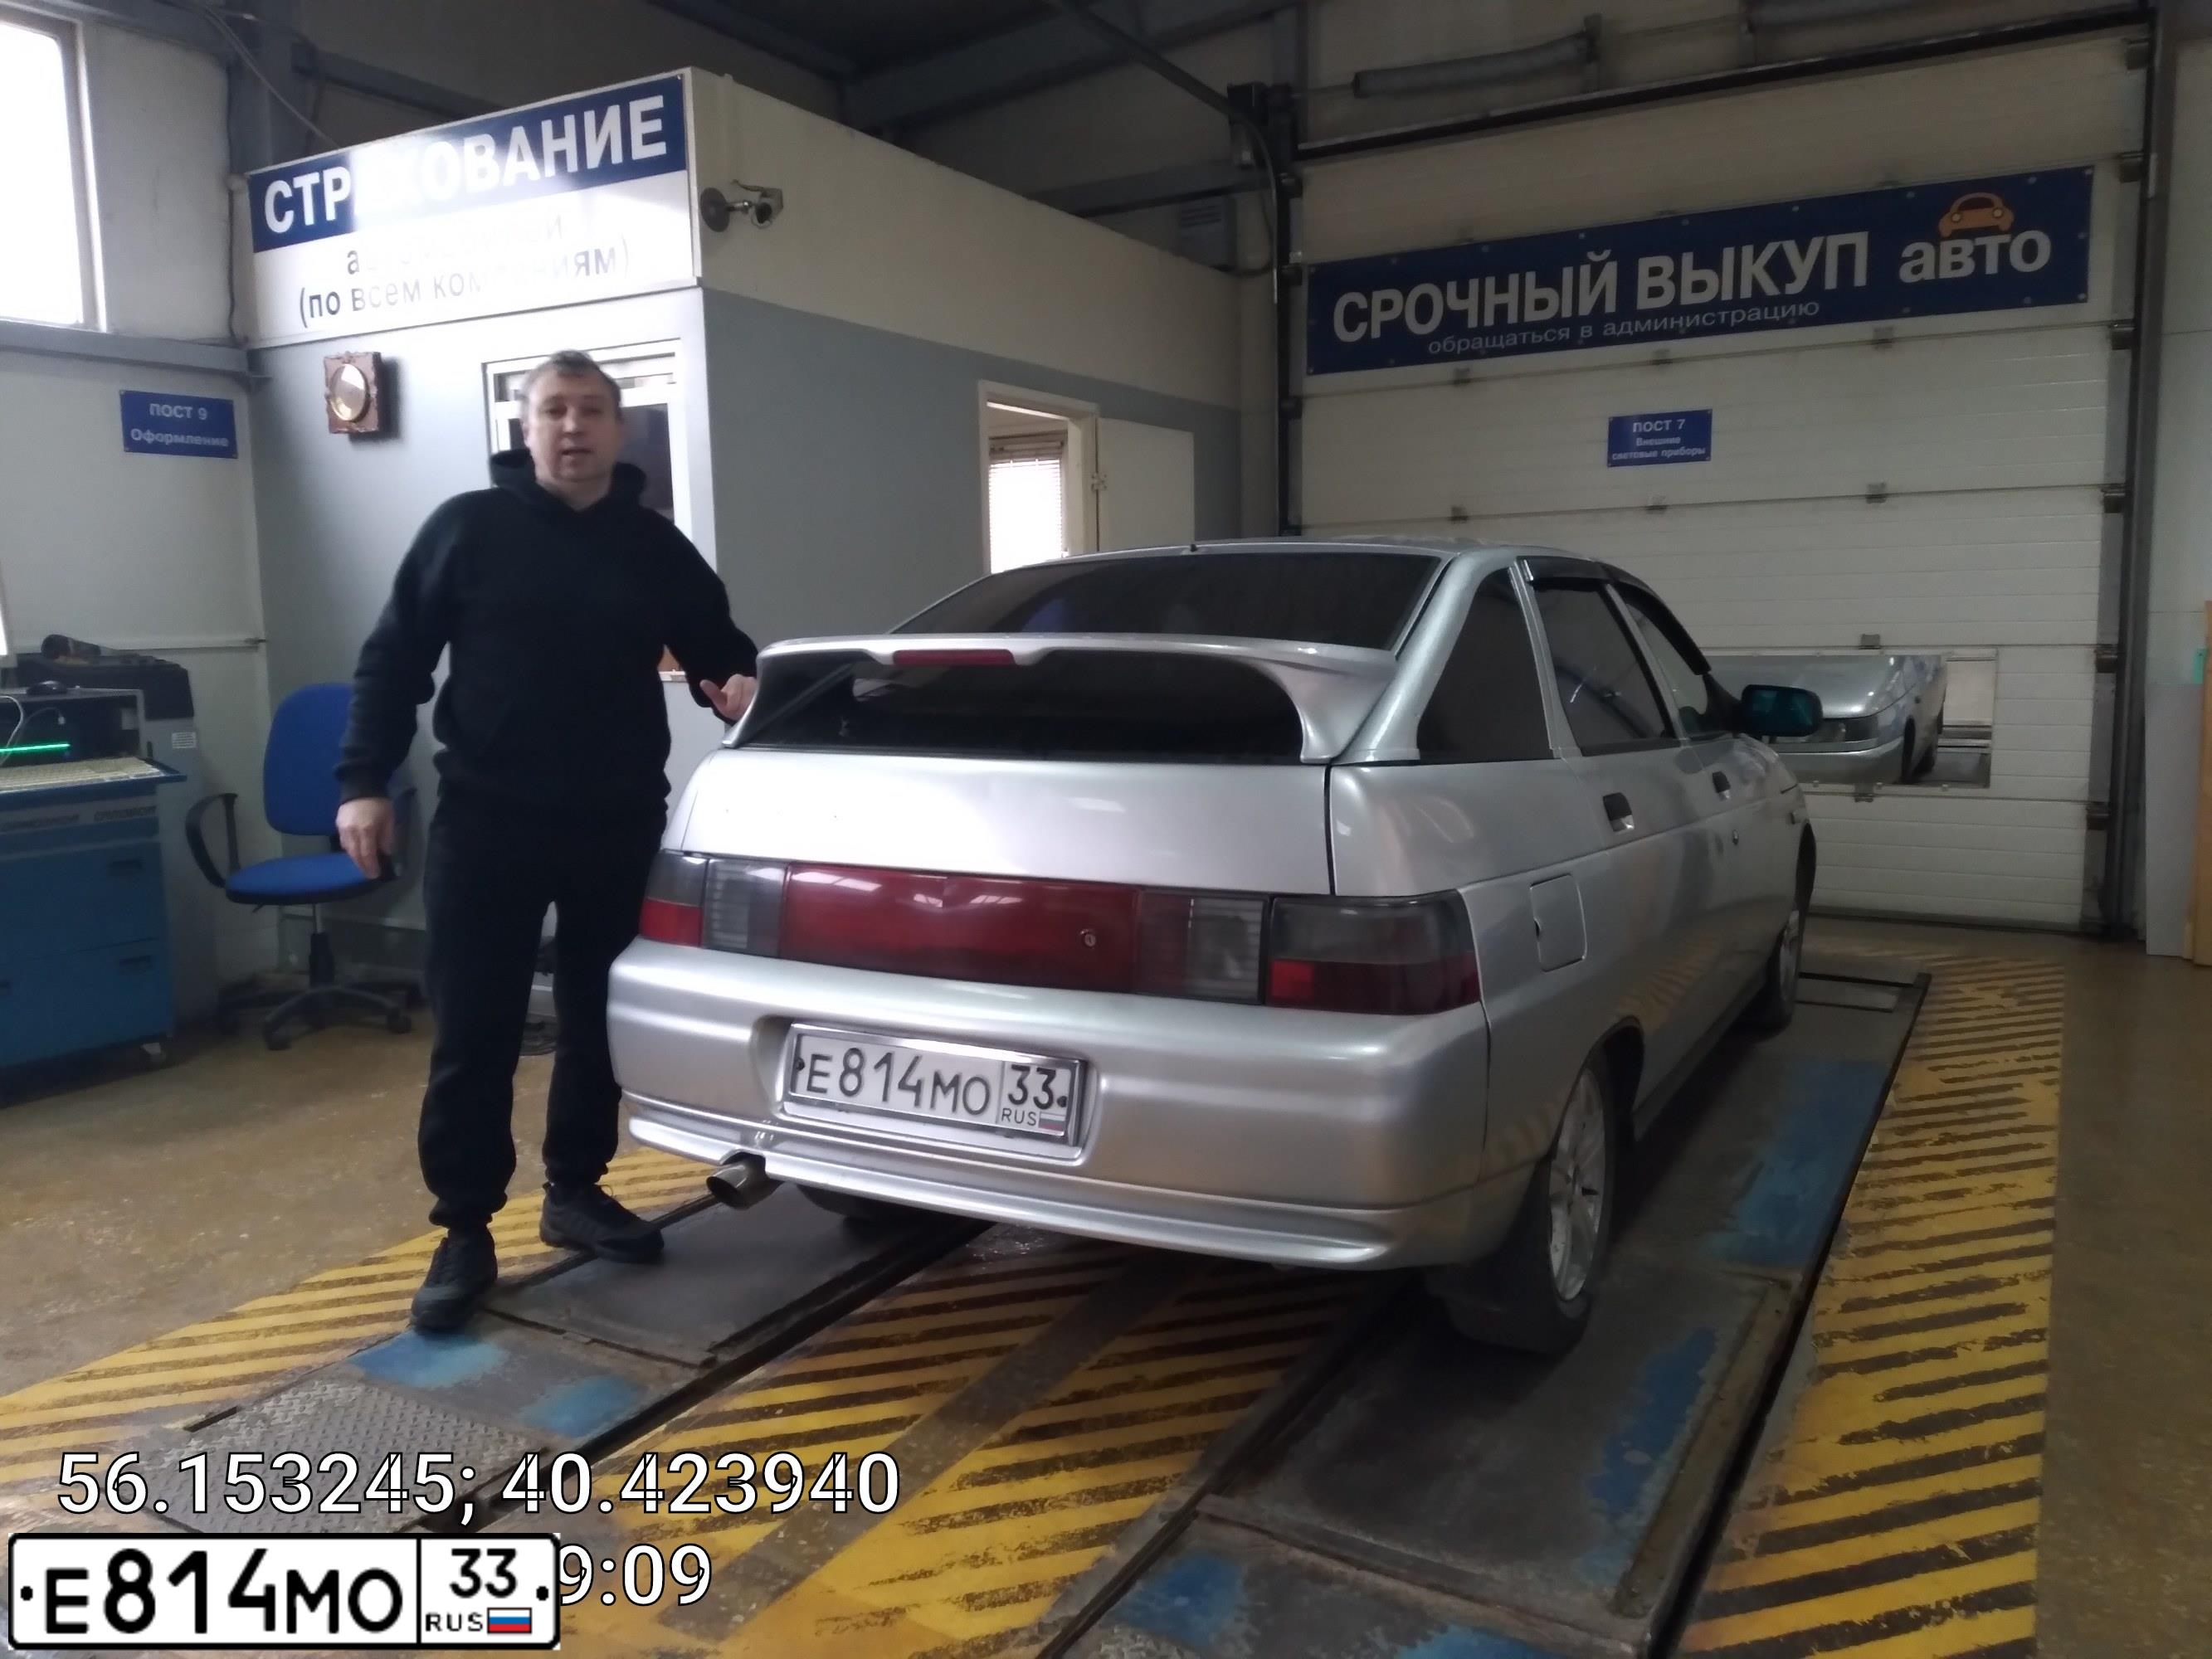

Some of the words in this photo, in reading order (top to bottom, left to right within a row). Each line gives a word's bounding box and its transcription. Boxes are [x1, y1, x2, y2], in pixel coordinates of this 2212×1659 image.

[263, 94, 666, 233] СТРОВАНИЕ
[1333, 250, 1617, 343] СРОЧНЫЙ
[1636, 231, 1868, 310] ВЫКУП
[1899, 230, 2051, 283] авто
[300, 287, 341, 328] (по
[351, 280, 421, 312] всем
[1428, 327, 1570, 354] обращаться
[1580, 325, 1593, 338] в
[1603, 301, 1820, 337] администрацию
[149, 403, 193, 420] ПОСТ
[198, 406, 208, 421] 9
[1632, 420, 1672, 432] ПОСТ
[1676, 419, 1686, 430] 7
[130, 428, 230, 448] Оформление
[1661, 446, 1706, 458] приборы
[806, 1047, 991, 1116] Е814МО
[1007, 1065, 1057, 1110] 33
[1001, 1107, 1037, 1126] RUS
